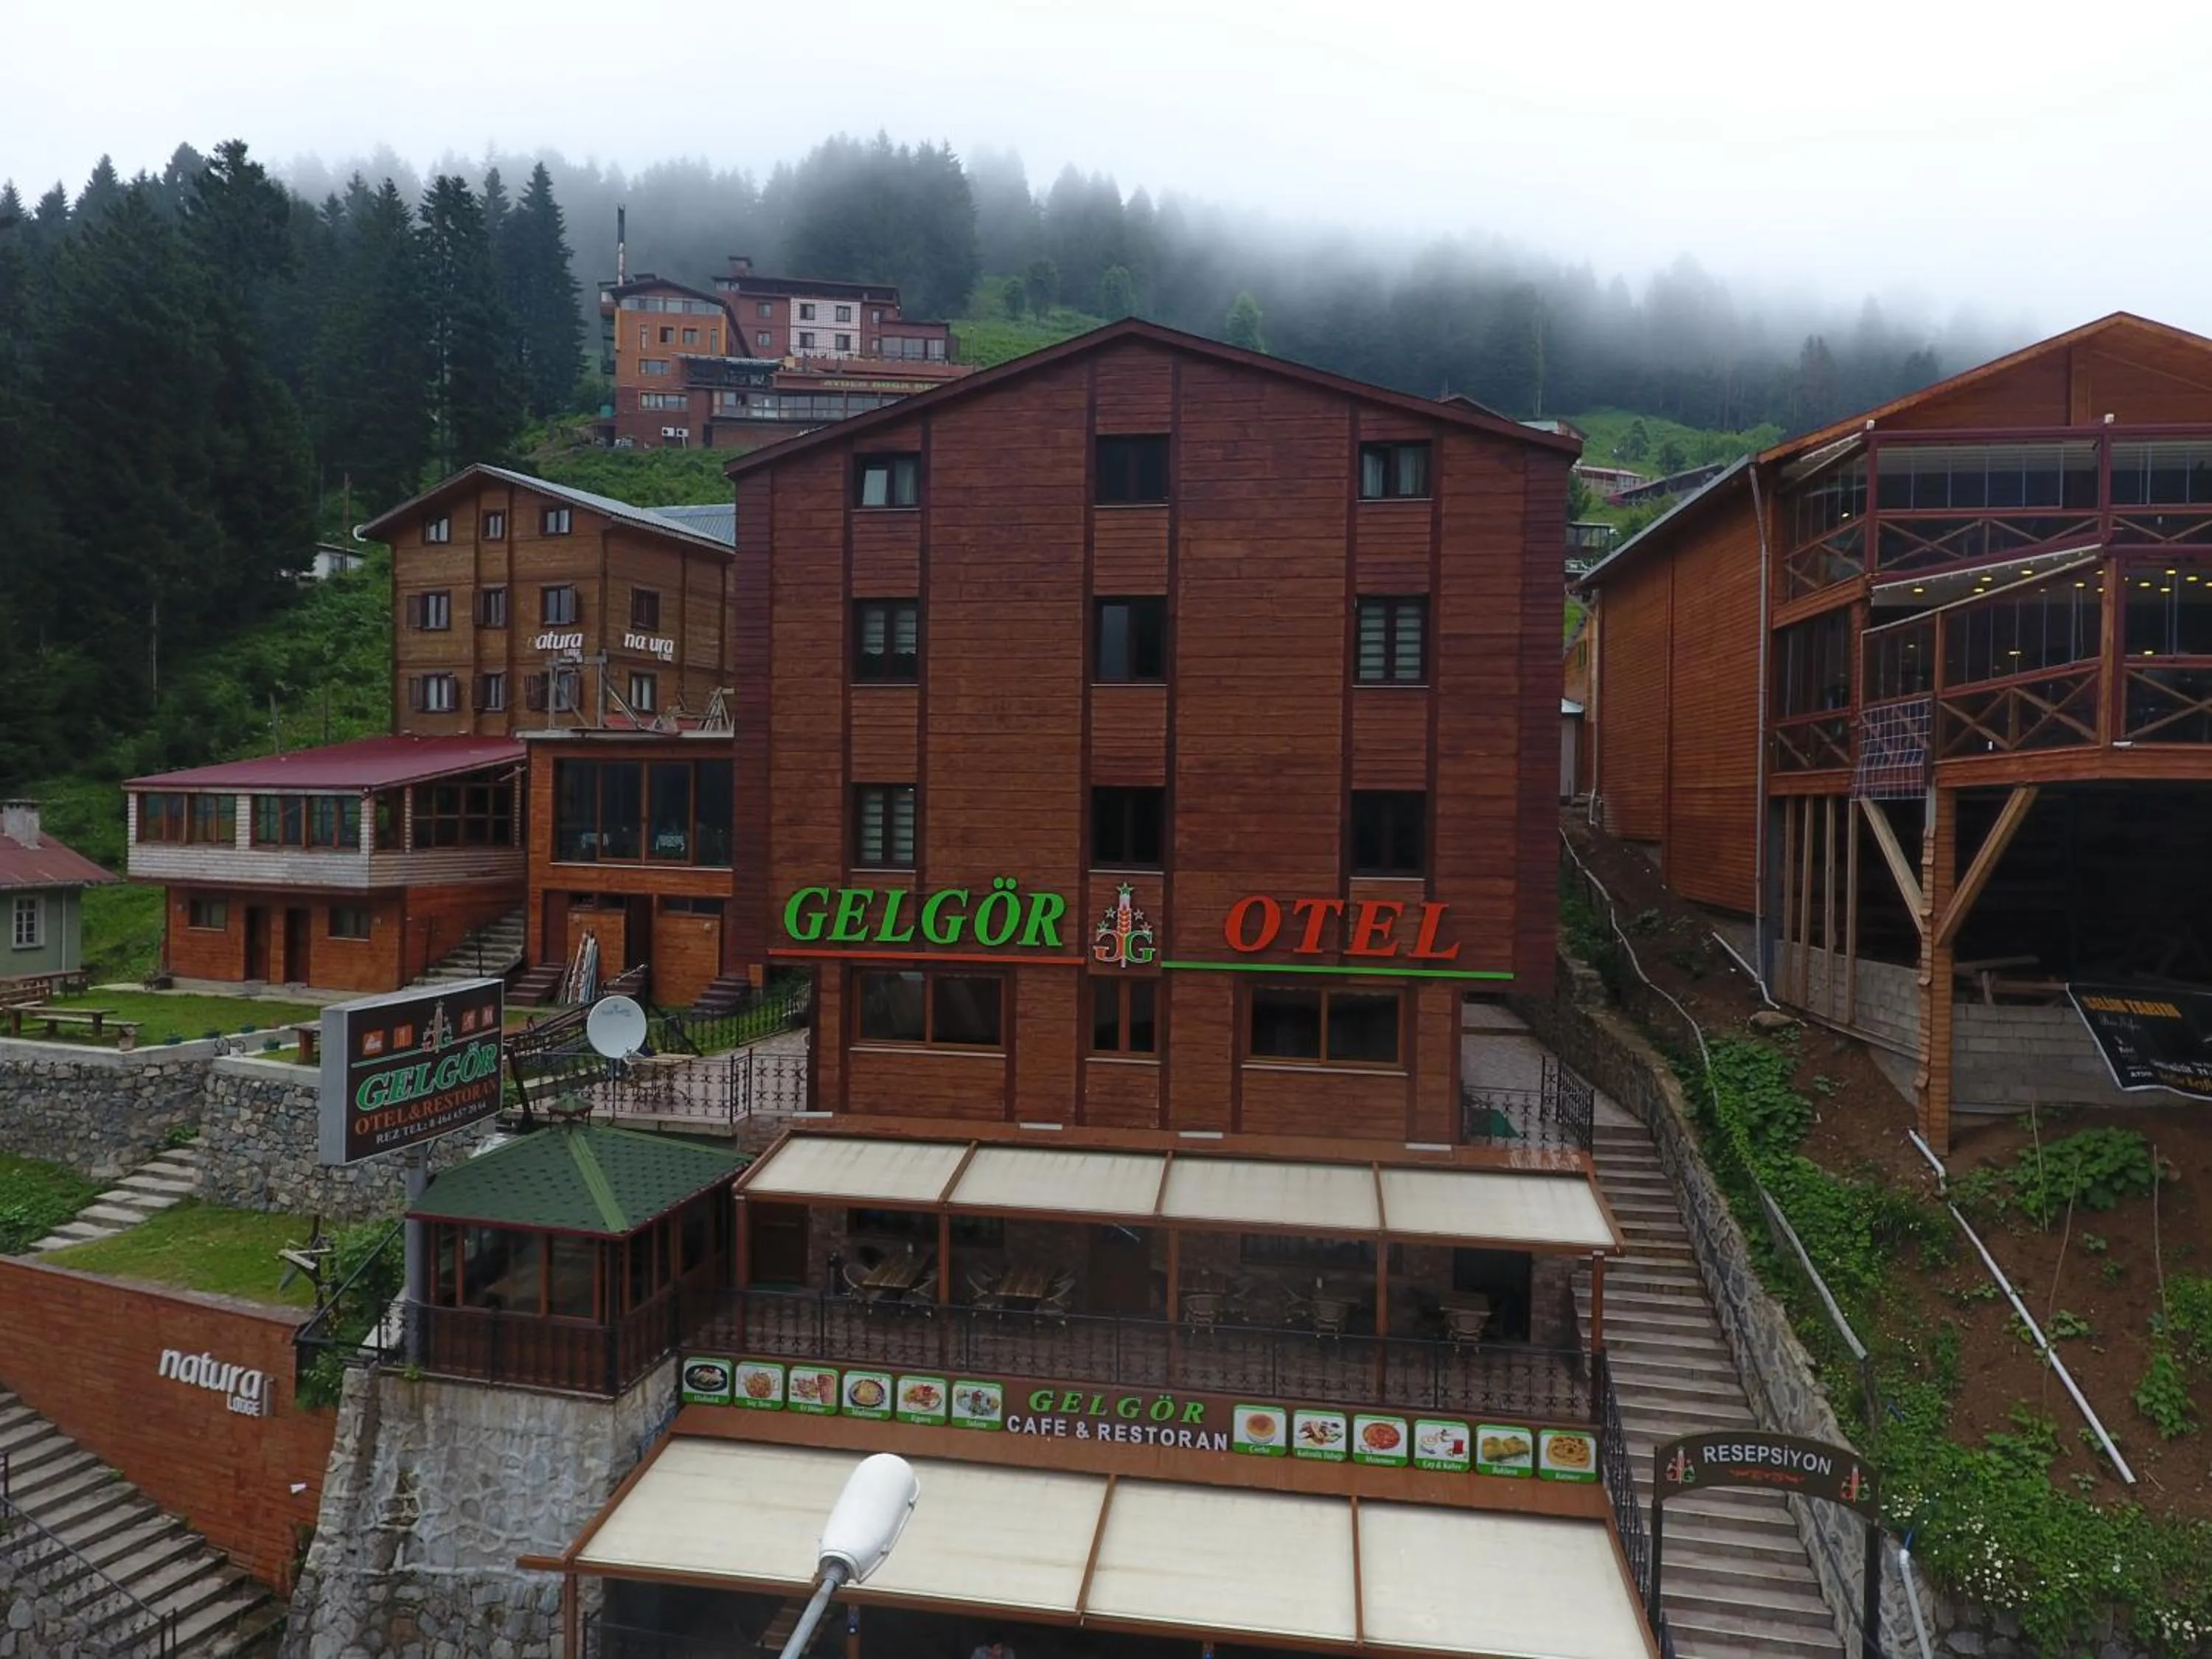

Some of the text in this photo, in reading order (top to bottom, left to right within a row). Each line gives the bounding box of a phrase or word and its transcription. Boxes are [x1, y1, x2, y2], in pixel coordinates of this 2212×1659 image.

[784, 877, 1461, 959] GELGÖR OTEL
[355, 1040, 498, 1111] GELGÖR
[159, 1349, 263, 1399] natura
[1029, 1390, 1204, 1424] GELGÖR
[1007, 1415, 1228, 1451] CAFE & RESTORAN
[1703, 1444, 1832, 1475] RESEPSİYON
